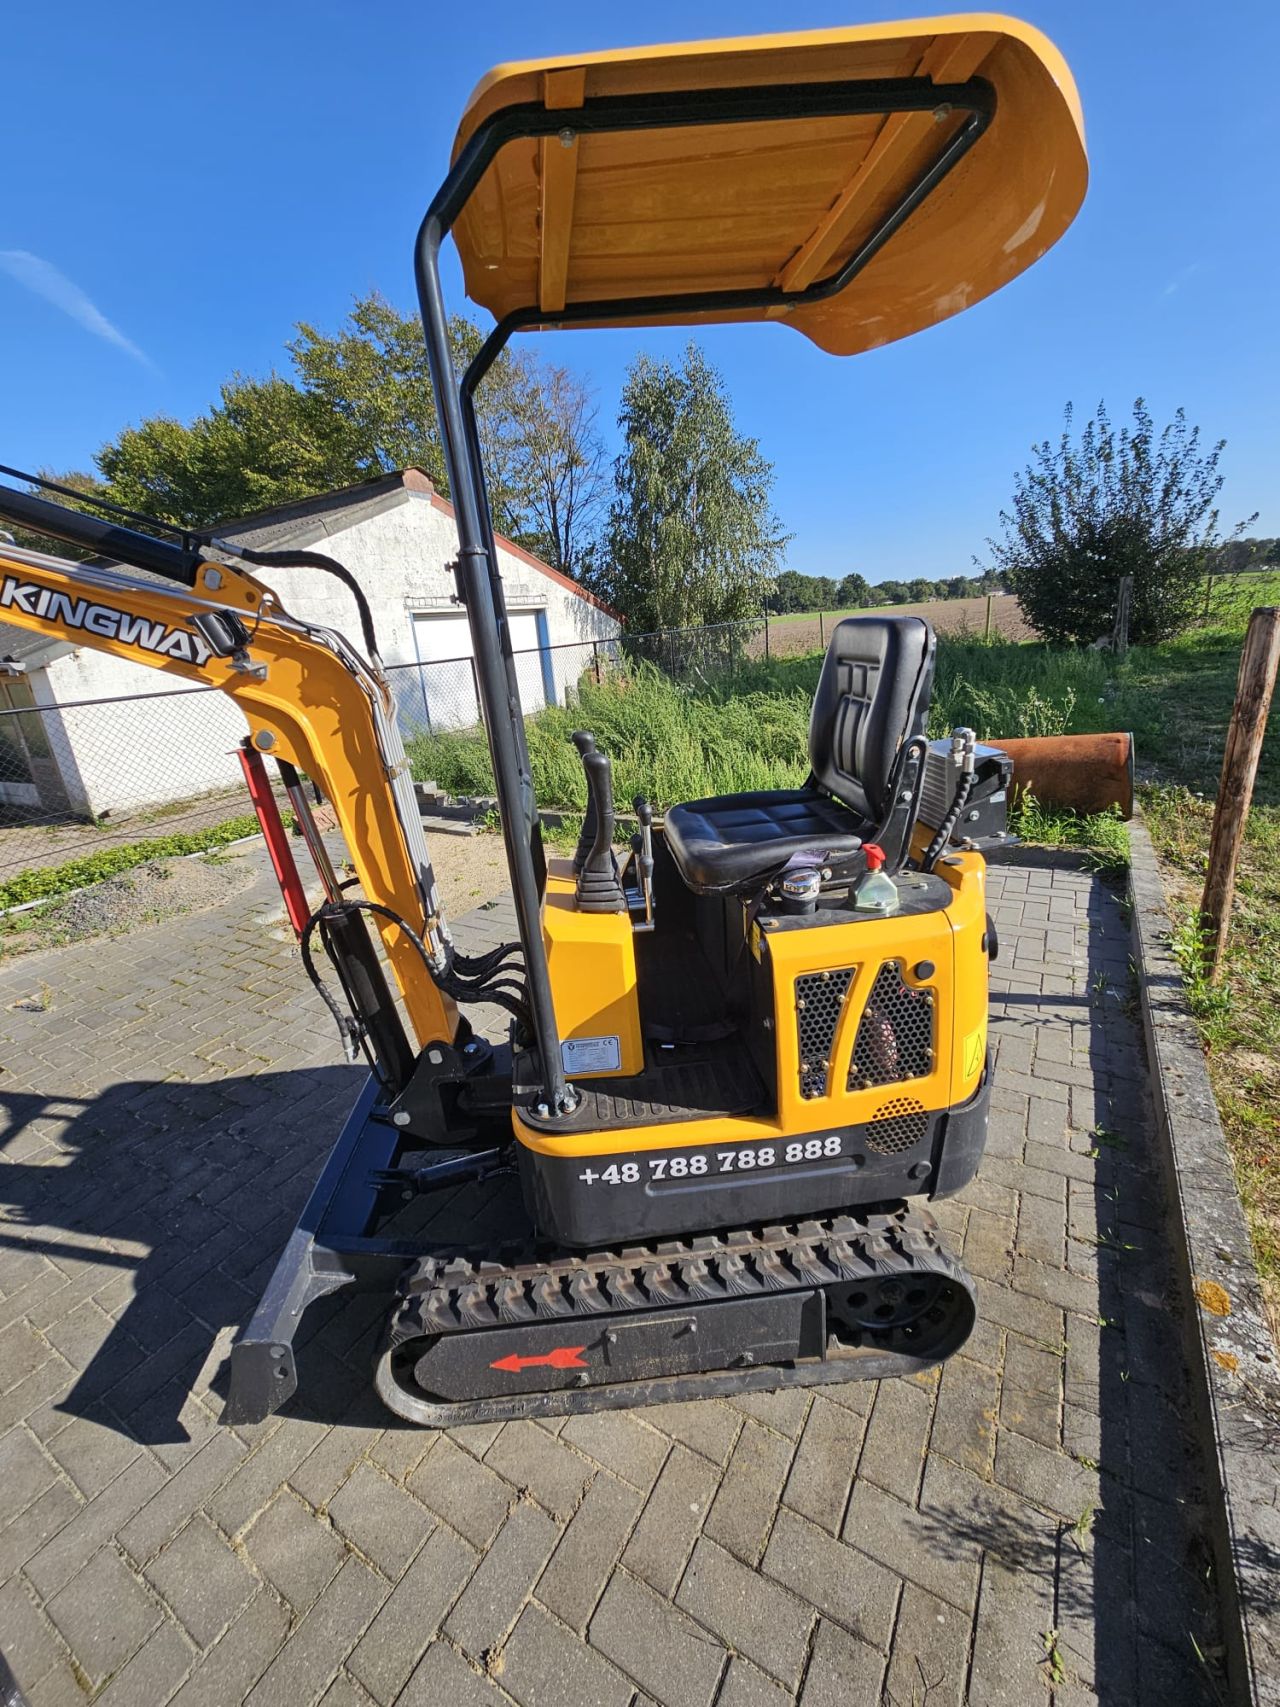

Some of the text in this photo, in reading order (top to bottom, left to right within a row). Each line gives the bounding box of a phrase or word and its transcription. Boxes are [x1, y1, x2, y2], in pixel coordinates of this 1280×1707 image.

[1, 578, 212, 666] KINGWAY
[579, 1136, 842, 1186] +48 788 788 888
